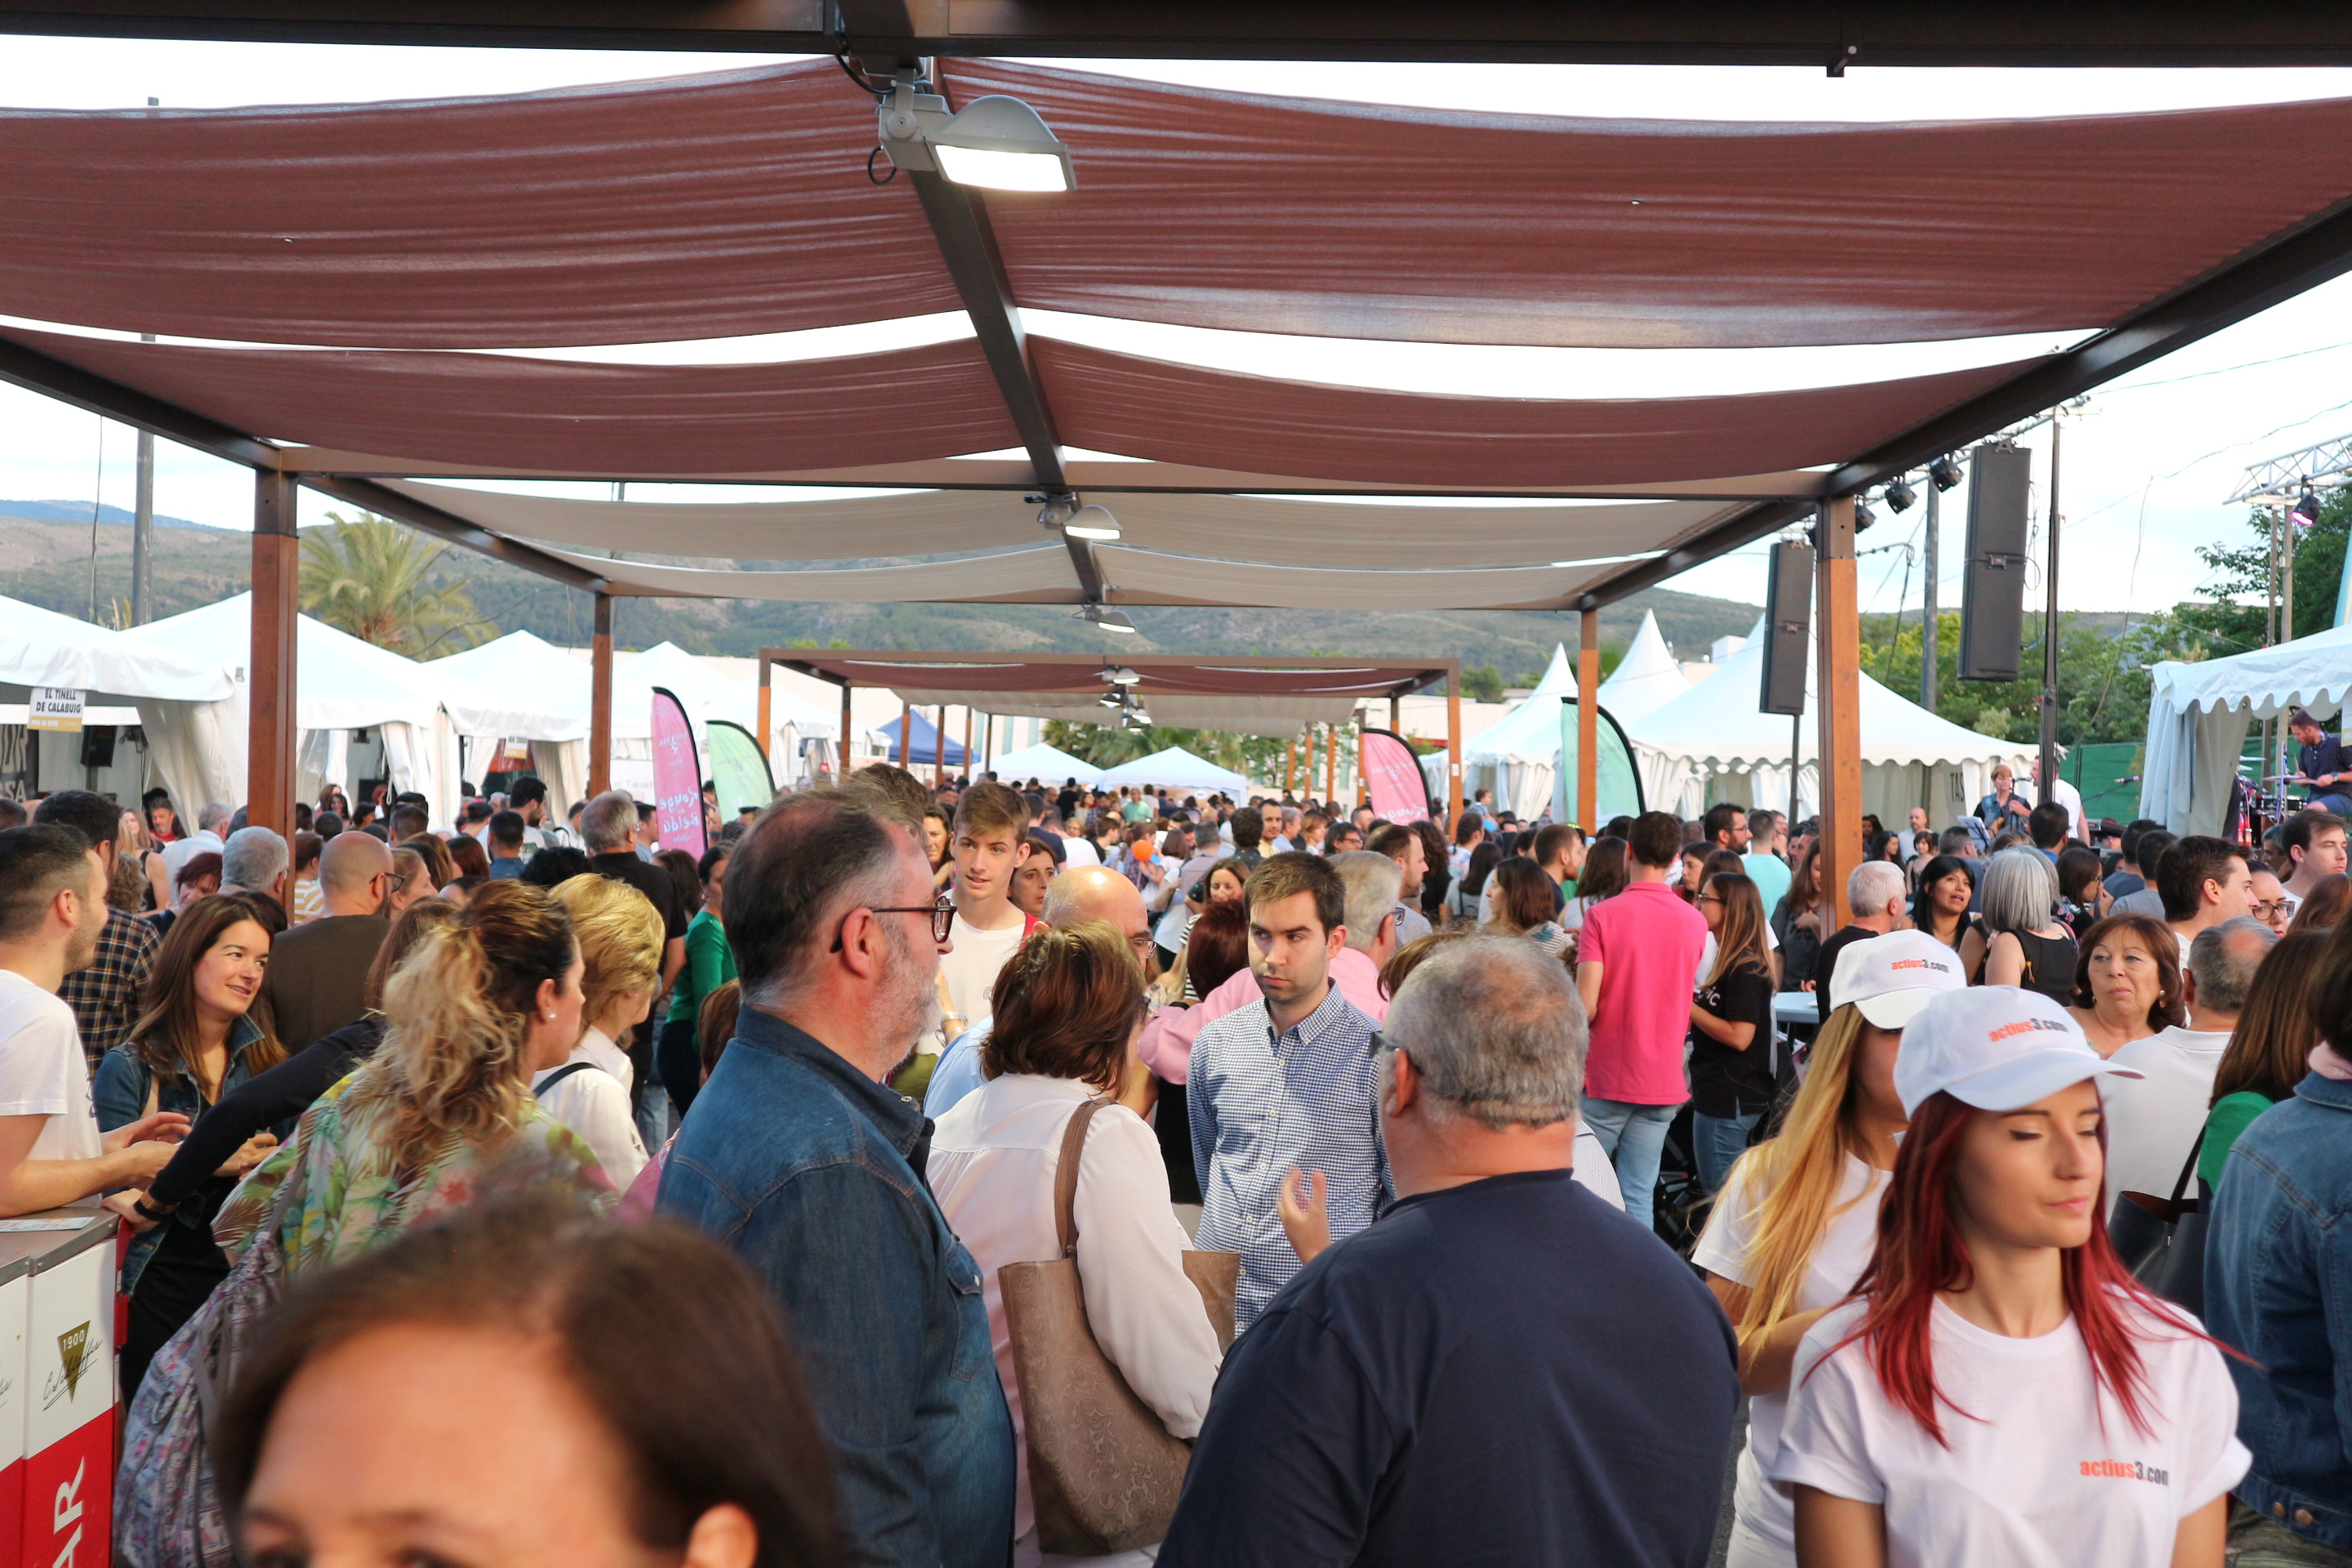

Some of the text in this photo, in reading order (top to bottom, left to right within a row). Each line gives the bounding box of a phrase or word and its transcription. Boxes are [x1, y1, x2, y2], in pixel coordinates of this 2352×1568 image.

[45, 688, 76, 700] EL TINELL
[36, 702, 81, 713] DE CALABUIG
[0, 779, 27, 803] SA
[1950, 772, 1965, 802] TAS
[1891, 959, 1949, 973] actius3.com
[1988, 1018, 2070, 1043] actius3.com
[63, 1330, 84, 1352] 1900
